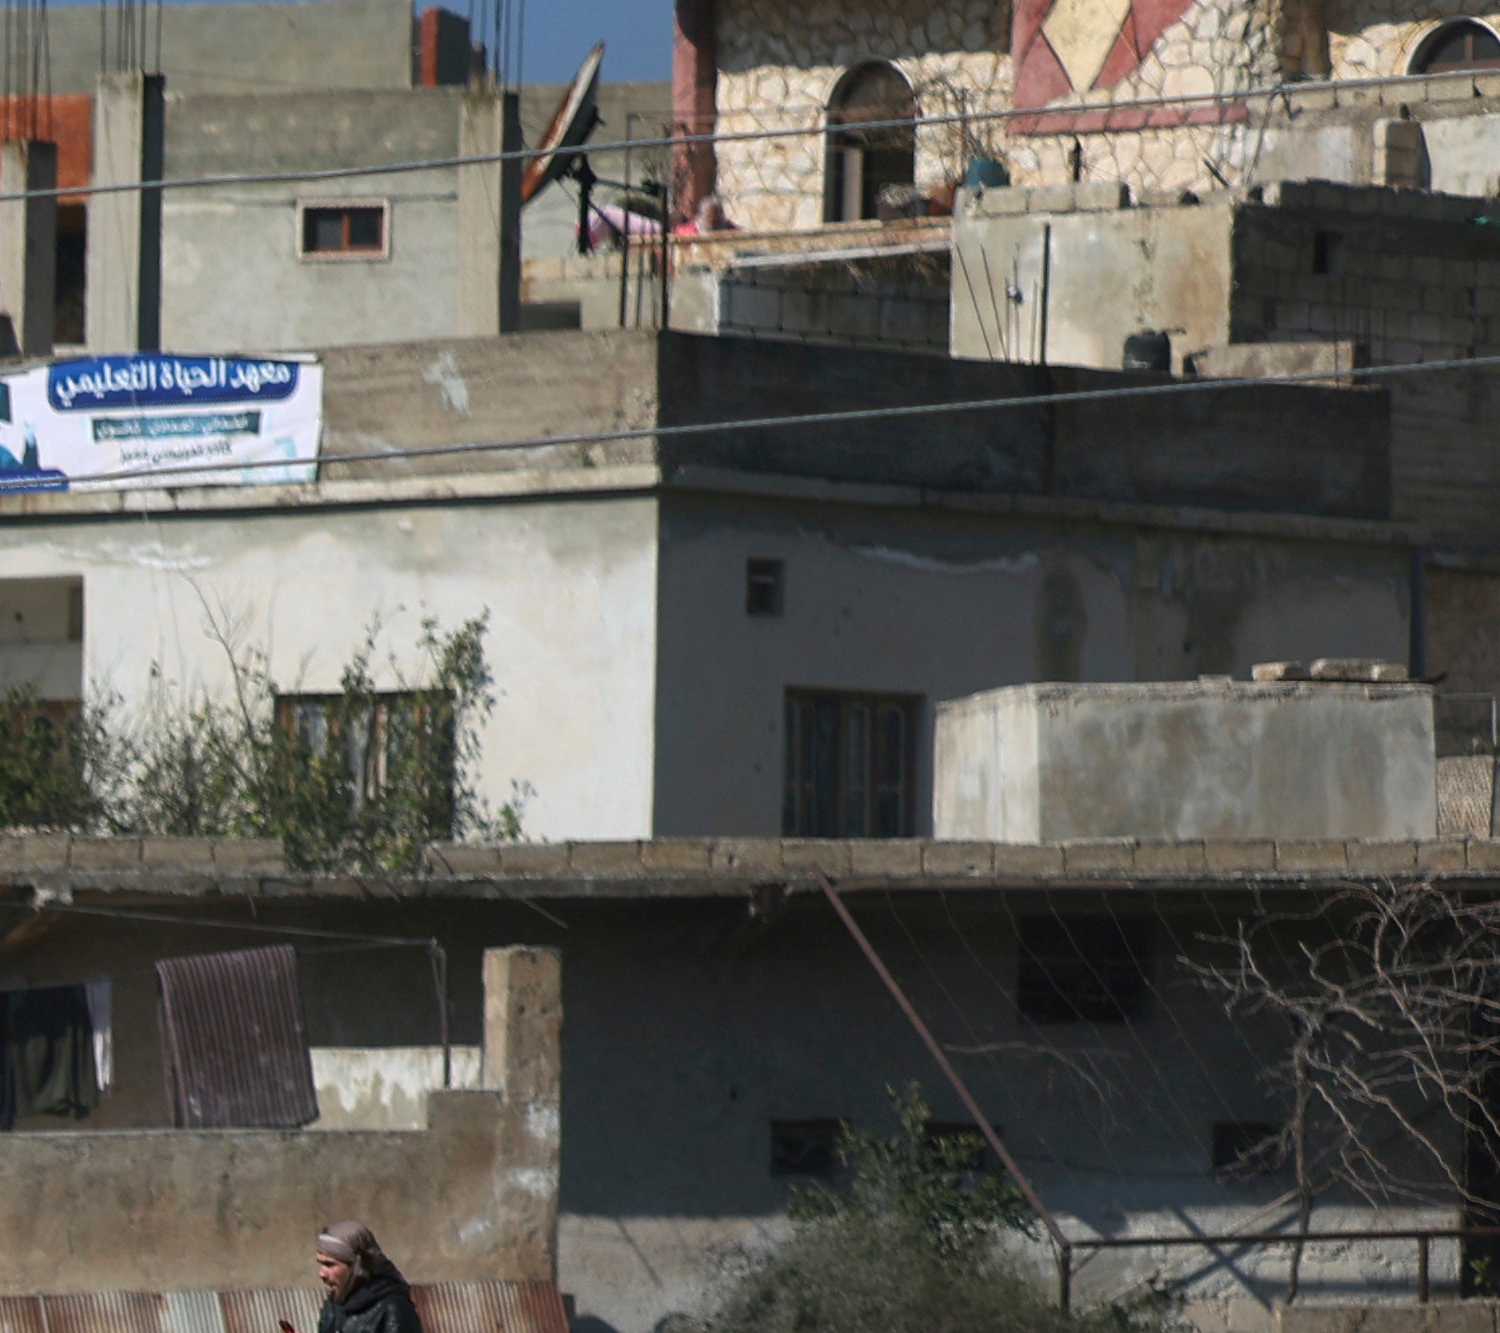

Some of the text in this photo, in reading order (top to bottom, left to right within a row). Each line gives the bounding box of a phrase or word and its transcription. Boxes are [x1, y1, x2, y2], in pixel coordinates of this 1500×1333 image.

[55, 356, 291, 407] معهد الحياة التعليمي
